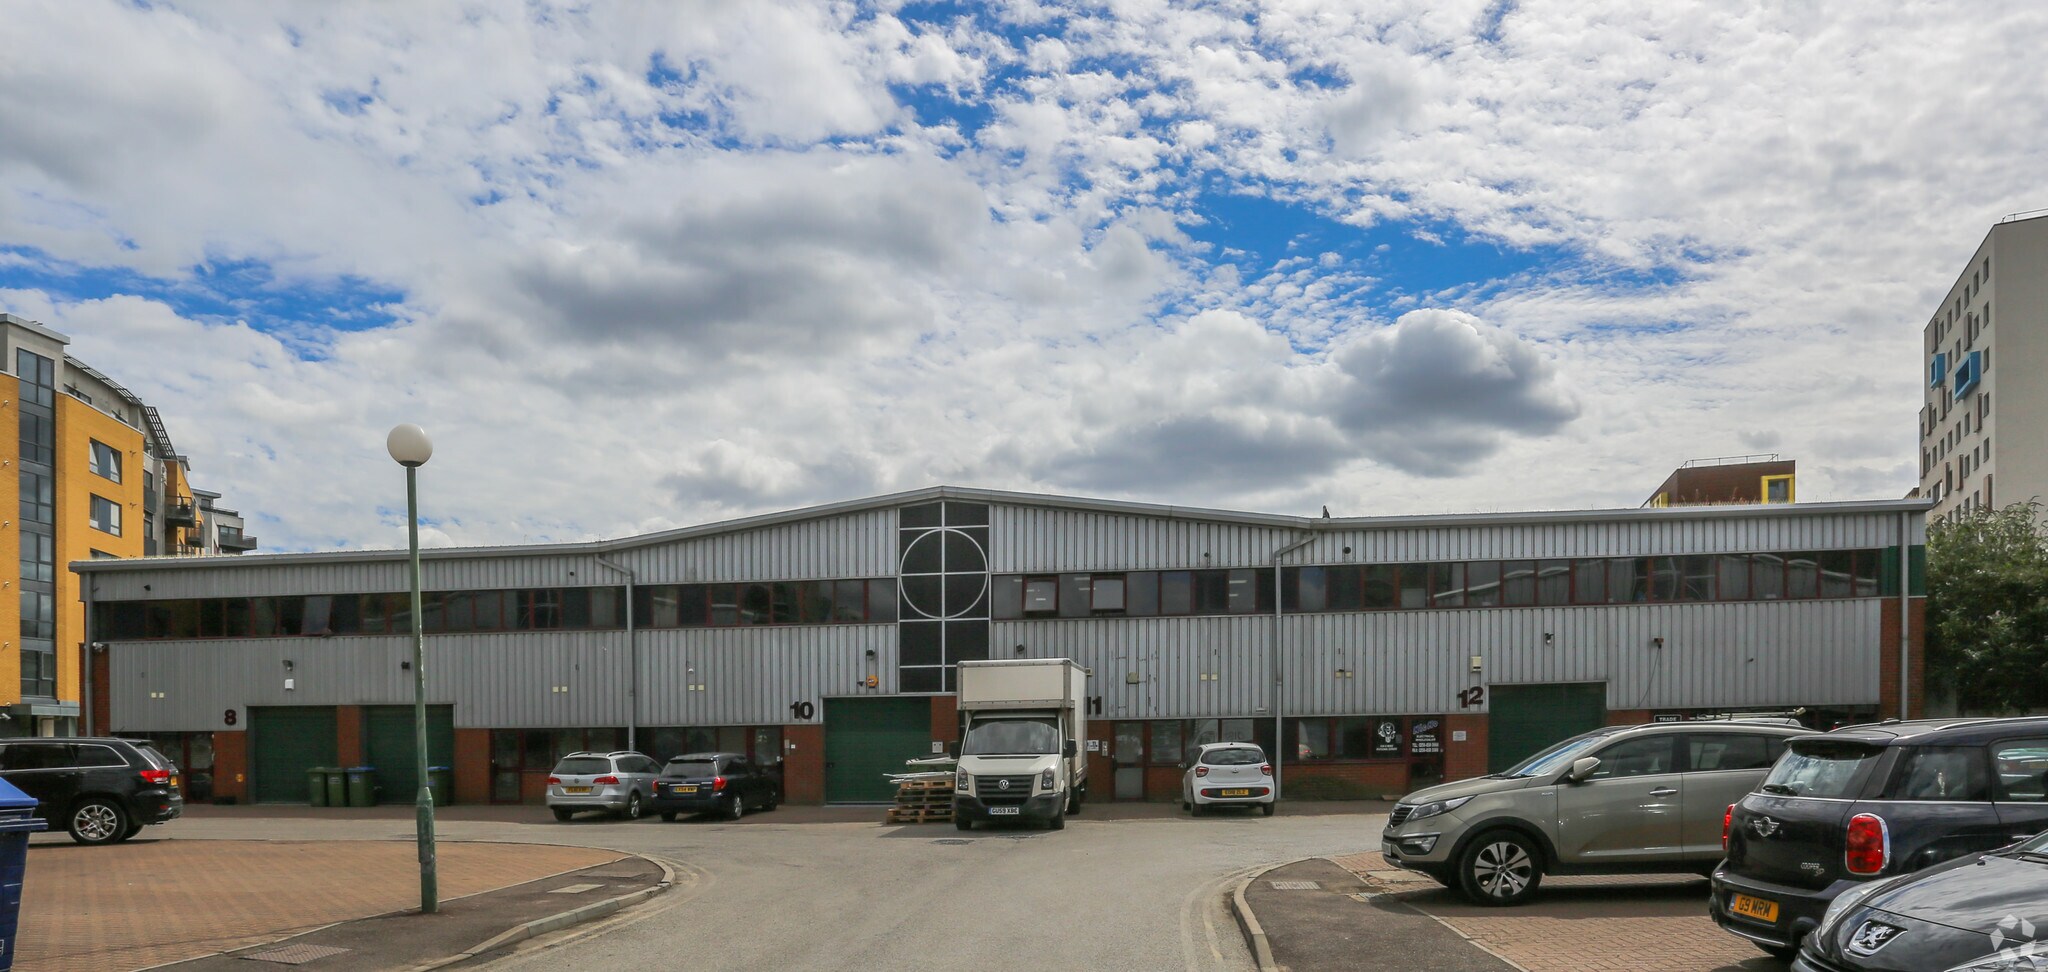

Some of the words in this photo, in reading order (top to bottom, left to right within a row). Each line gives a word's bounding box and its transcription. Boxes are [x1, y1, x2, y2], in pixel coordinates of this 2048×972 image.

[1456, 686, 1483, 708] 12
[224, 709, 236, 726] 8
[790, 701, 814, 719] 10
[1738, 897, 1751, 912] G9
